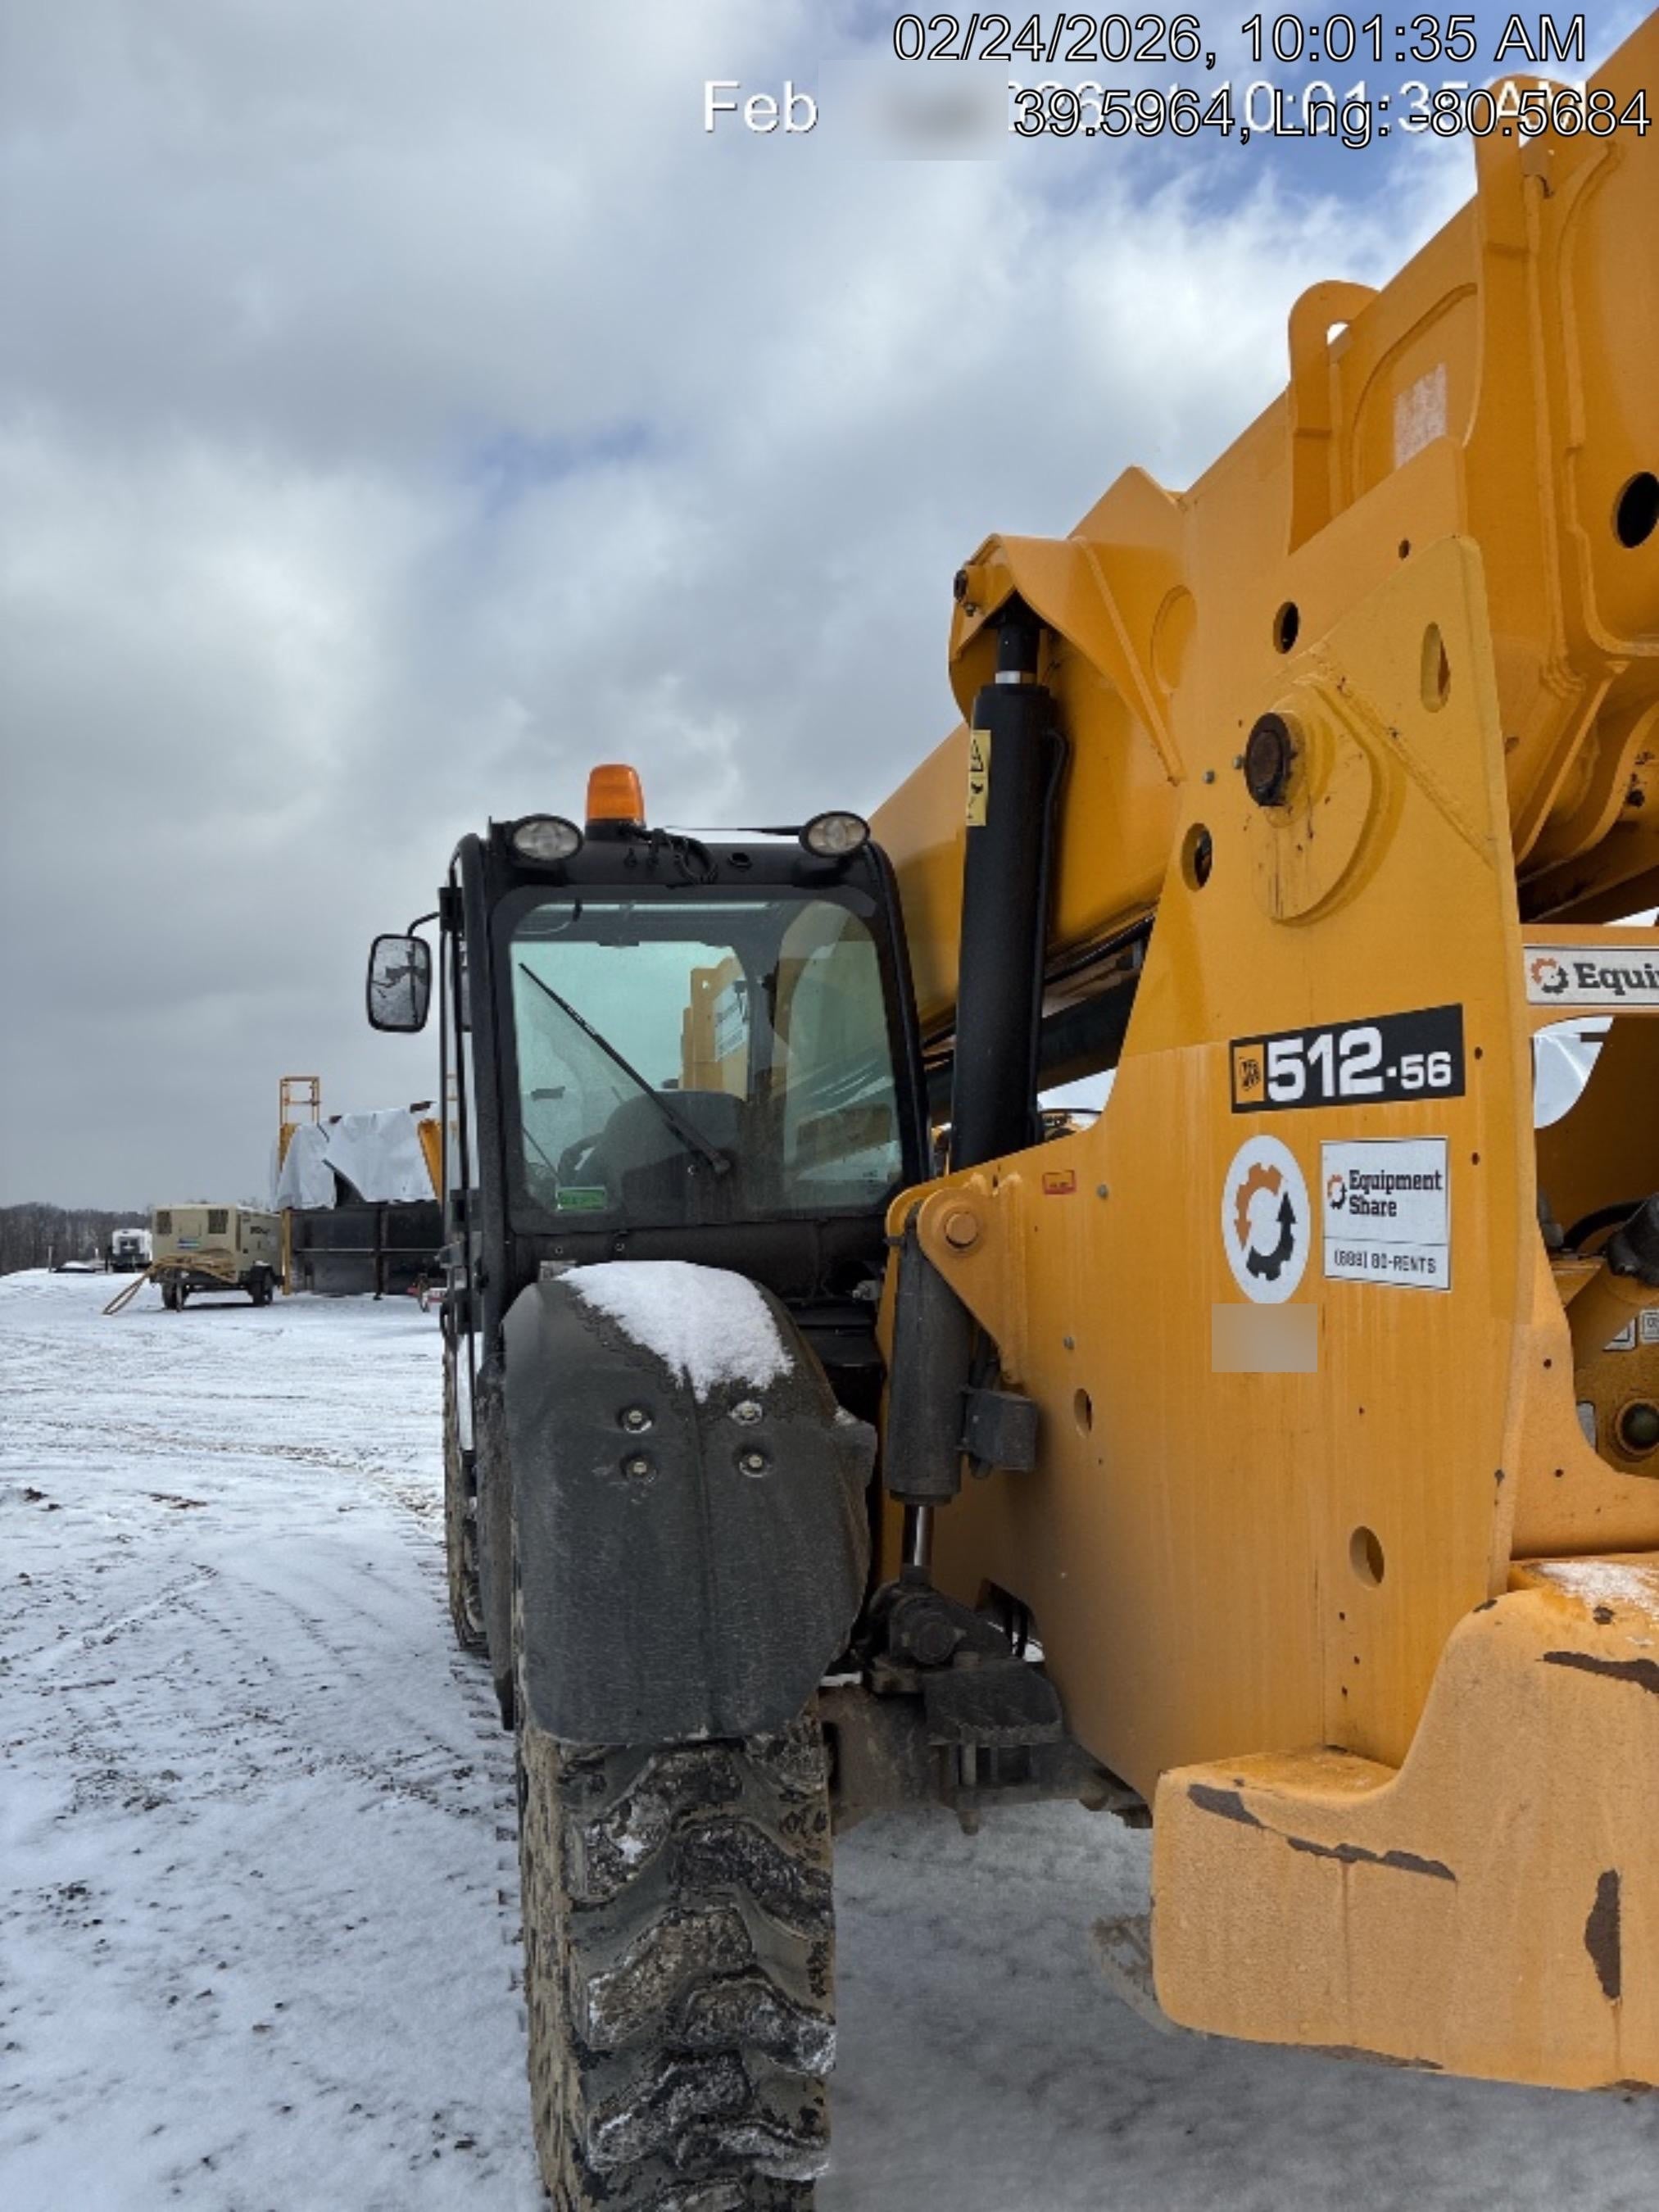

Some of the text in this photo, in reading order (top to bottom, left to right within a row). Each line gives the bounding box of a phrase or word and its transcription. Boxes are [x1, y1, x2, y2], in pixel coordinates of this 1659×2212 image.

[1573, 963, 1659, 995] Equi
[1349, 1169, 1443, 1194] Equipment
[1349, 1194, 1397, 1217] Share
